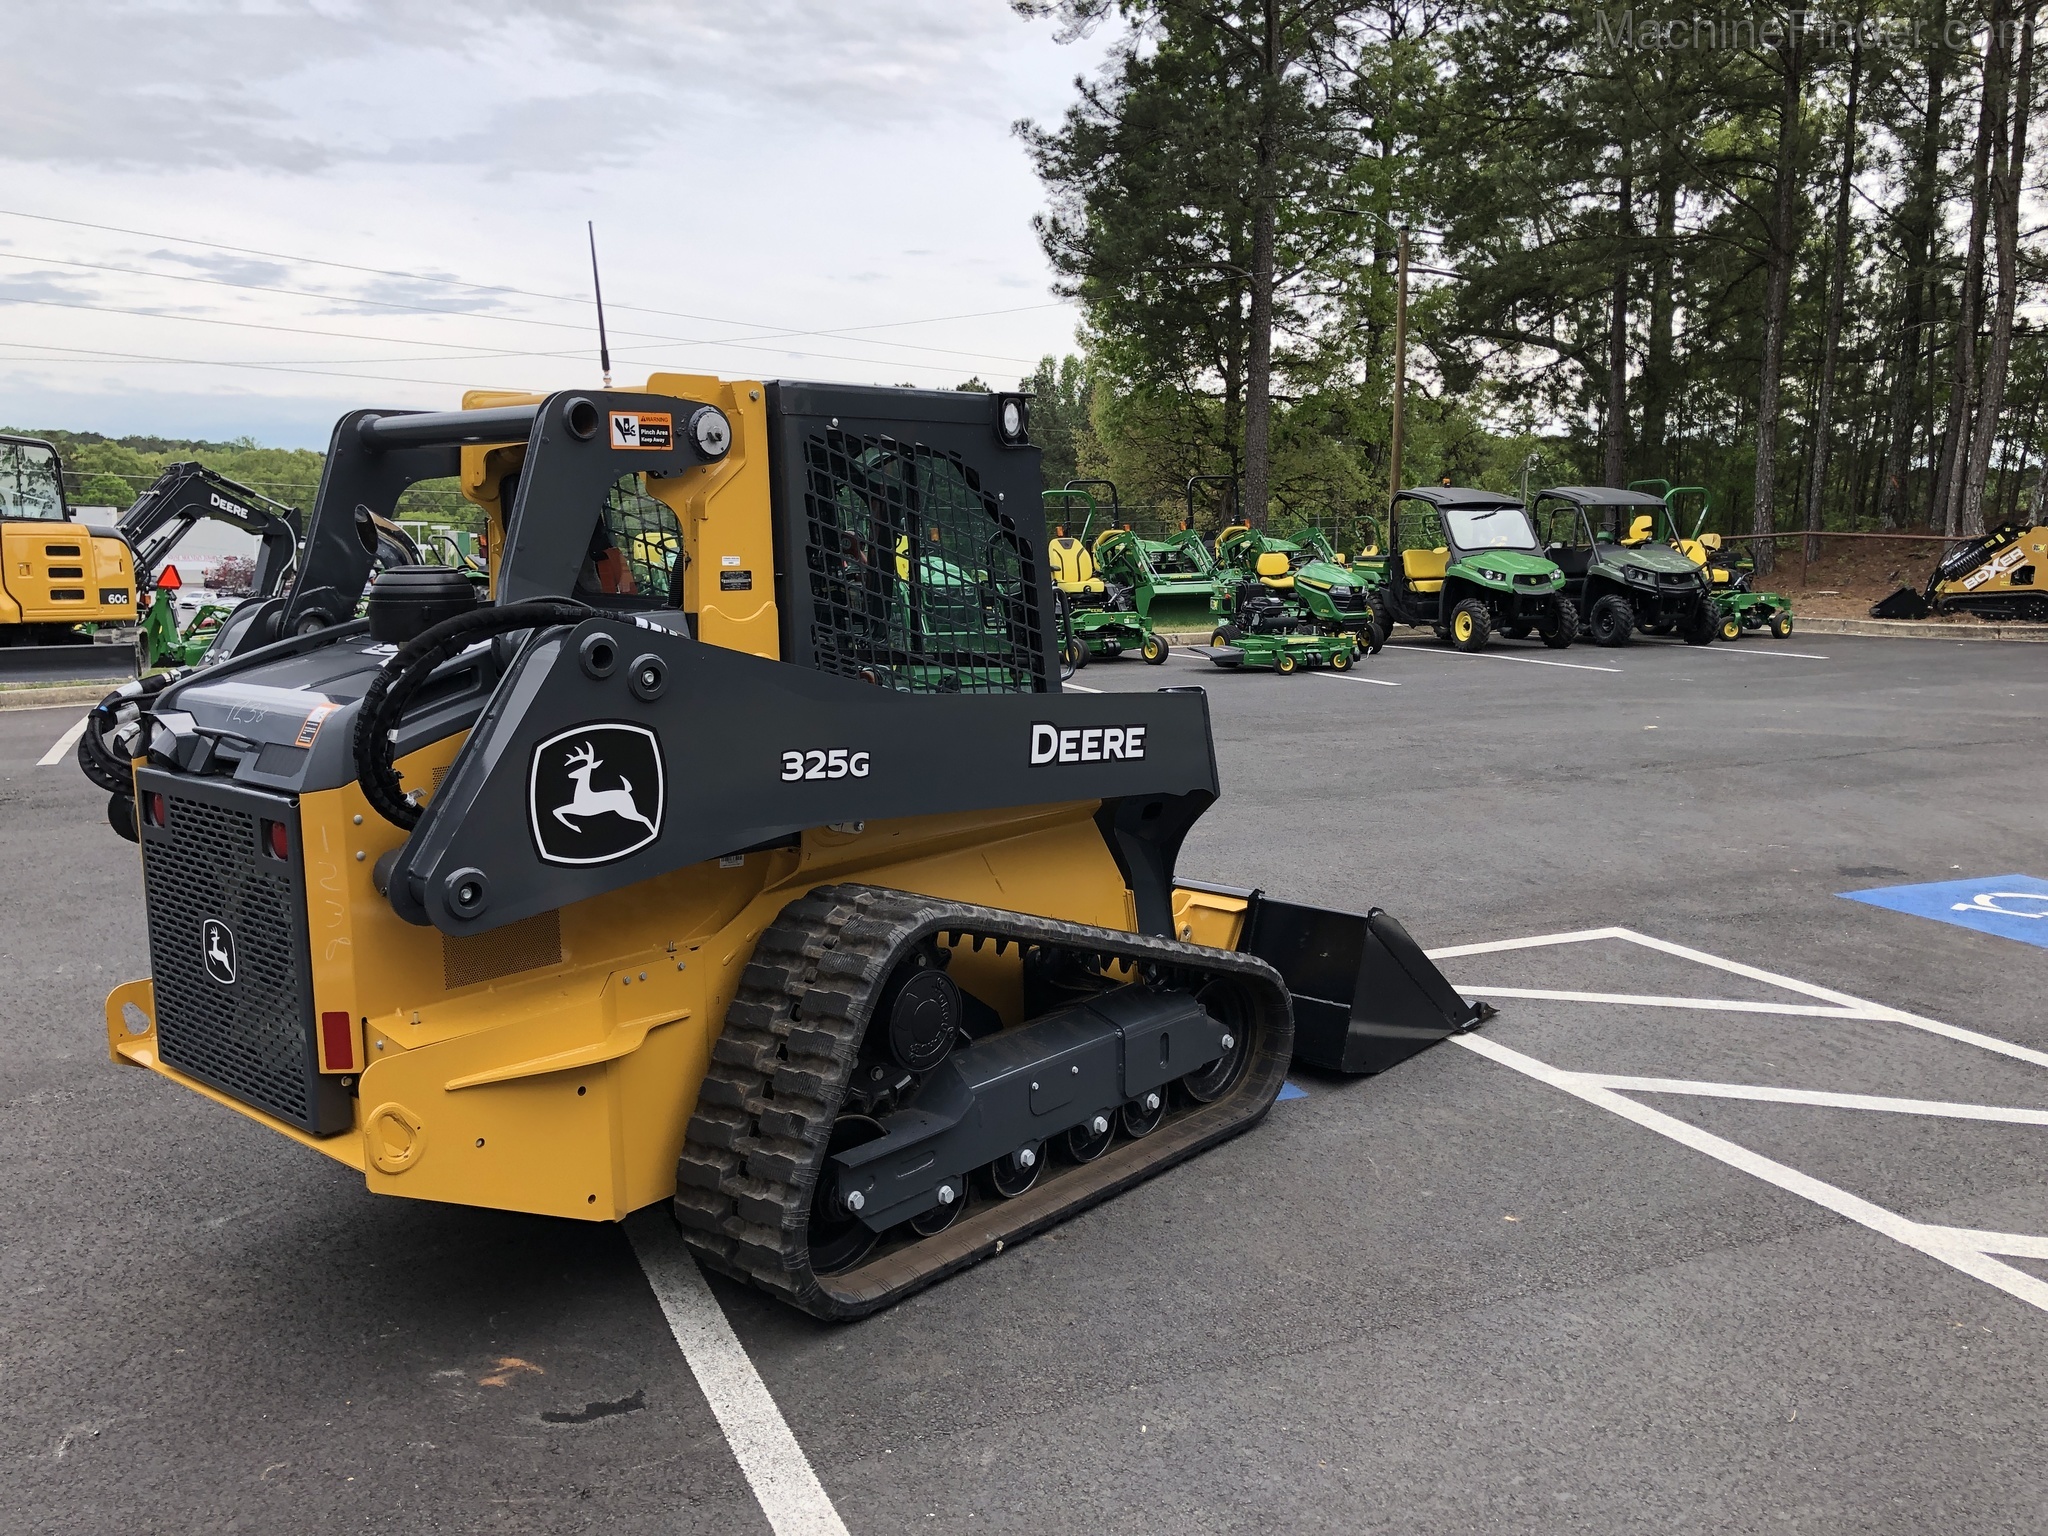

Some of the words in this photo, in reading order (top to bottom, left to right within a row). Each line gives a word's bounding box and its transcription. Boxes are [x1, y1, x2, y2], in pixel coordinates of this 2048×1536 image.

[640, 428, 656, 436] Pinch
[640, 436, 653, 444] Keep
[210, 492, 249, 520] DEERE
[1963, 546, 2026, 591] BOXER
[107, 593, 128, 604] 60G
[1030, 723, 1146, 765] DEERE
[780, 749, 870, 782] 325G
